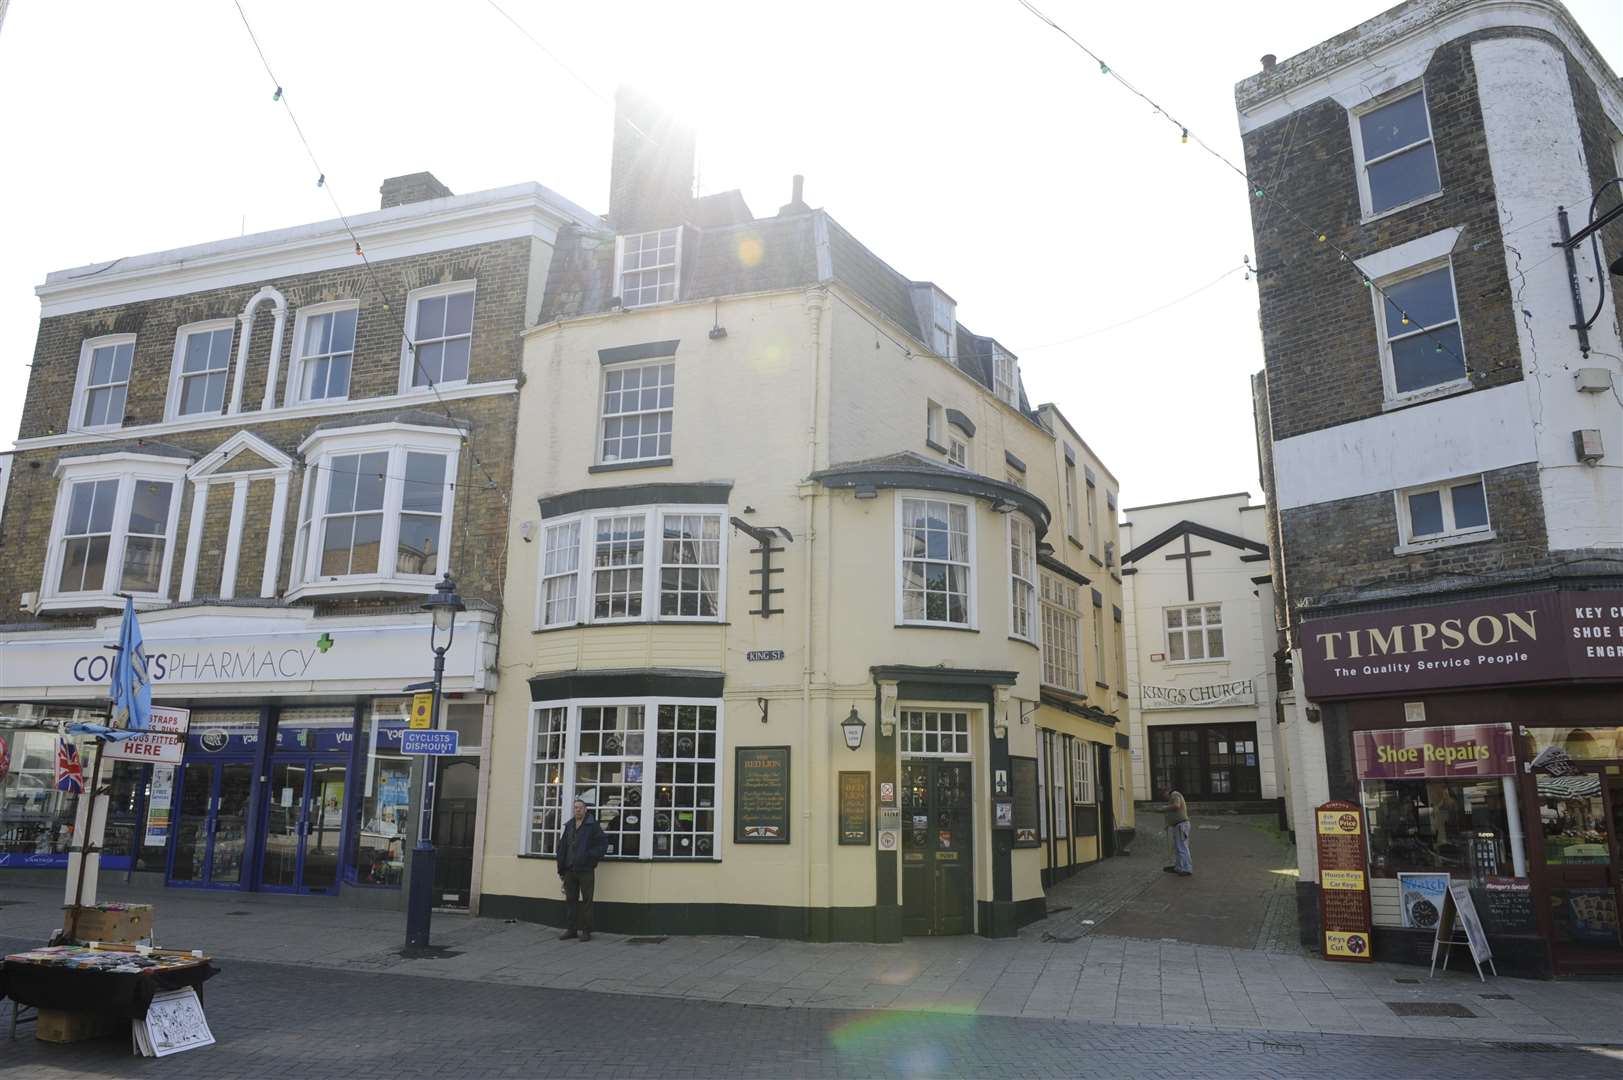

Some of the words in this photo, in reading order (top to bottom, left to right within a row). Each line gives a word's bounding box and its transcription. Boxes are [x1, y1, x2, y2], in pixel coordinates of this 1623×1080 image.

[1575, 607, 1602, 618] KEY
[1316, 610, 1537, 661] TIMPSON
[1573, 626, 1611, 638] SHOE
[750, 651, 770, 660] KING
[1334, 667, 1357, 677] The
[1363, 663, 1411, 676] Quality
[1417, 658, 1471, 670] Service
[1478, 652, 1529, 665] People
[1143, 685, 1187, 704] KINGS
[1189, 680, 1253, 702] CHURCH
[408, 734, 450, 742] CYCLISTS
[124, 743, 162, 756] HERE
[405, 743, 453, 751] DISMOUNT
[1377, 745, 1418, 763] Shoe
[1424, 741, 1490, 765] Repairs
[1328, 935, 1345, 943] Keys
